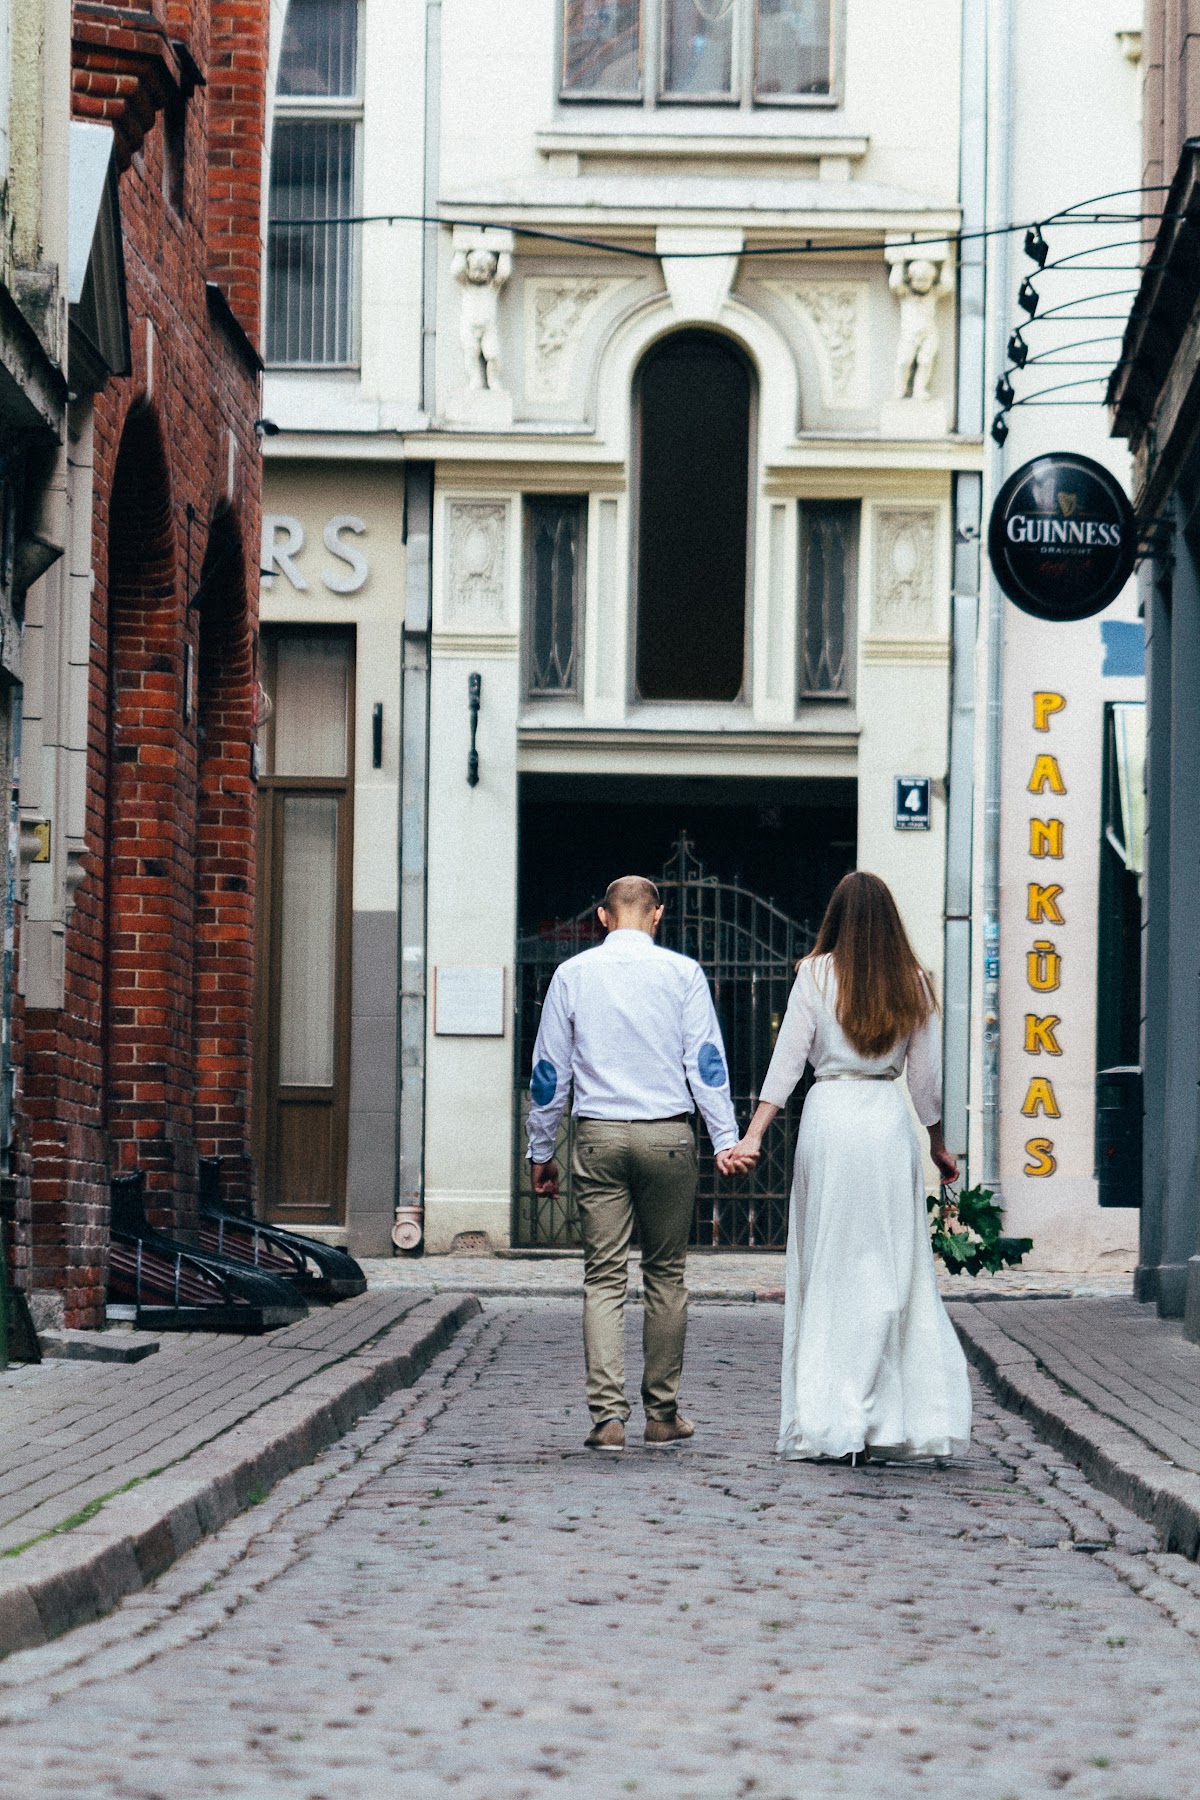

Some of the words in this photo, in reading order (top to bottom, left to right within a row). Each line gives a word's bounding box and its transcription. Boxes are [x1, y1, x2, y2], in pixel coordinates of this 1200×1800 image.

[1006, 514, 1121, 546] GUINNESS
[904, 788, 921, 812] 4
[1021, 691, 1067, 1178] PANKŪKAS
